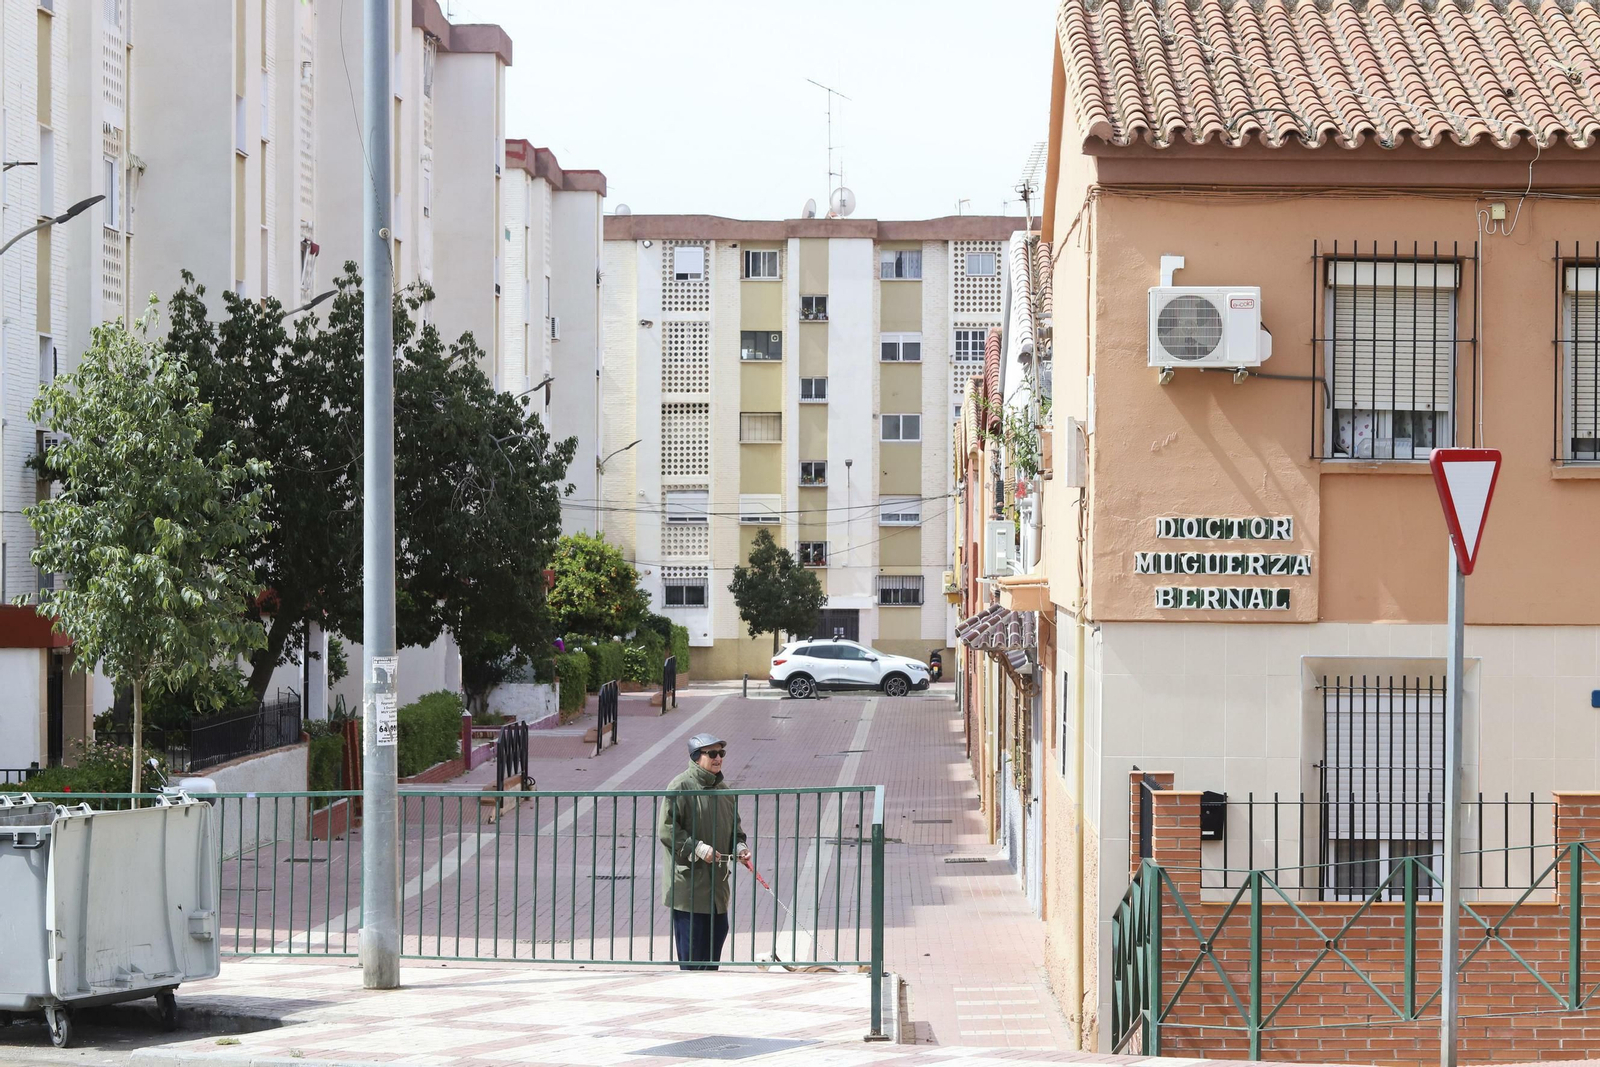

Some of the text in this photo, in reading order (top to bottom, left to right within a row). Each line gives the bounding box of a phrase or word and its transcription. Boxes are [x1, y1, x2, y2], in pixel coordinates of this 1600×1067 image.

[1157, 517, 1292, 540] DOCTOR
[1134, 553, 1311, 575] MUGUERZA
[1156, 588, 1290, 609] BERNAL
